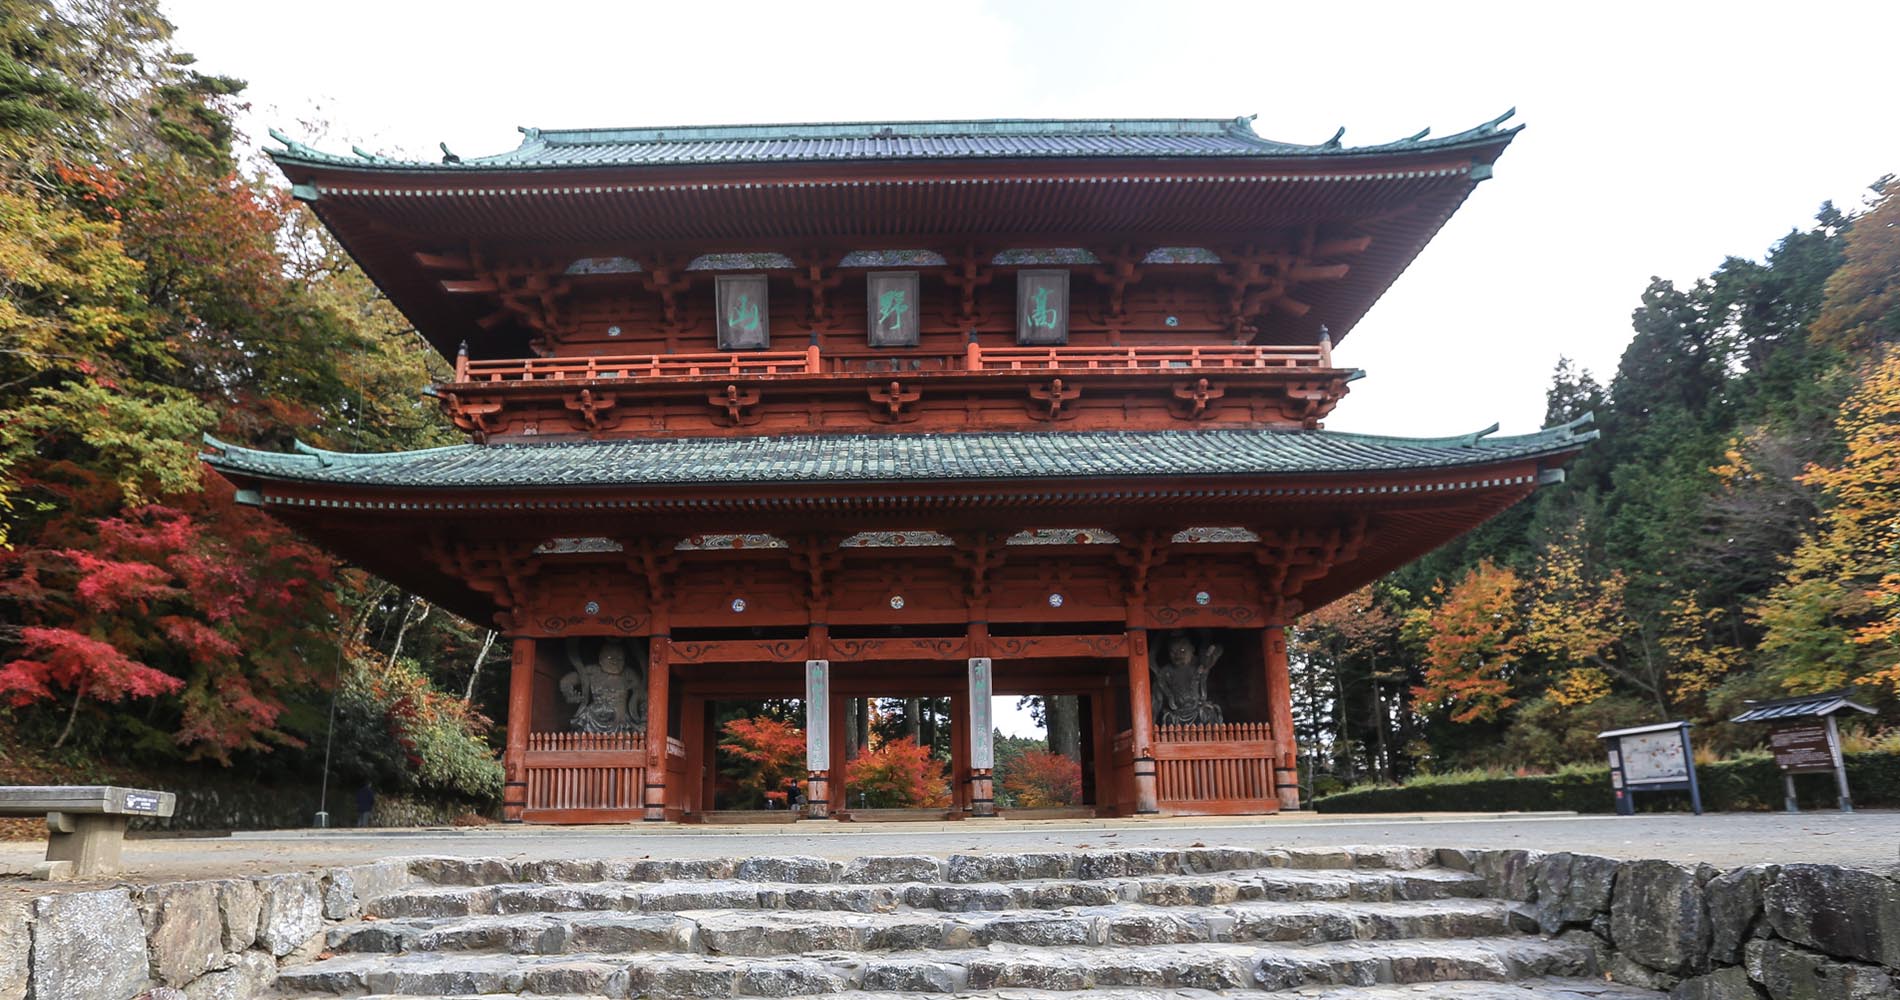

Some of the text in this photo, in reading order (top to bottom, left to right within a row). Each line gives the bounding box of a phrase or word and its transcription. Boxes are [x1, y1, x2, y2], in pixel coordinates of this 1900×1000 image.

[728, 295, 759, 330] 山
[878, 290, 907, 330] 野
[1027, 287, 1056, 329] 高
